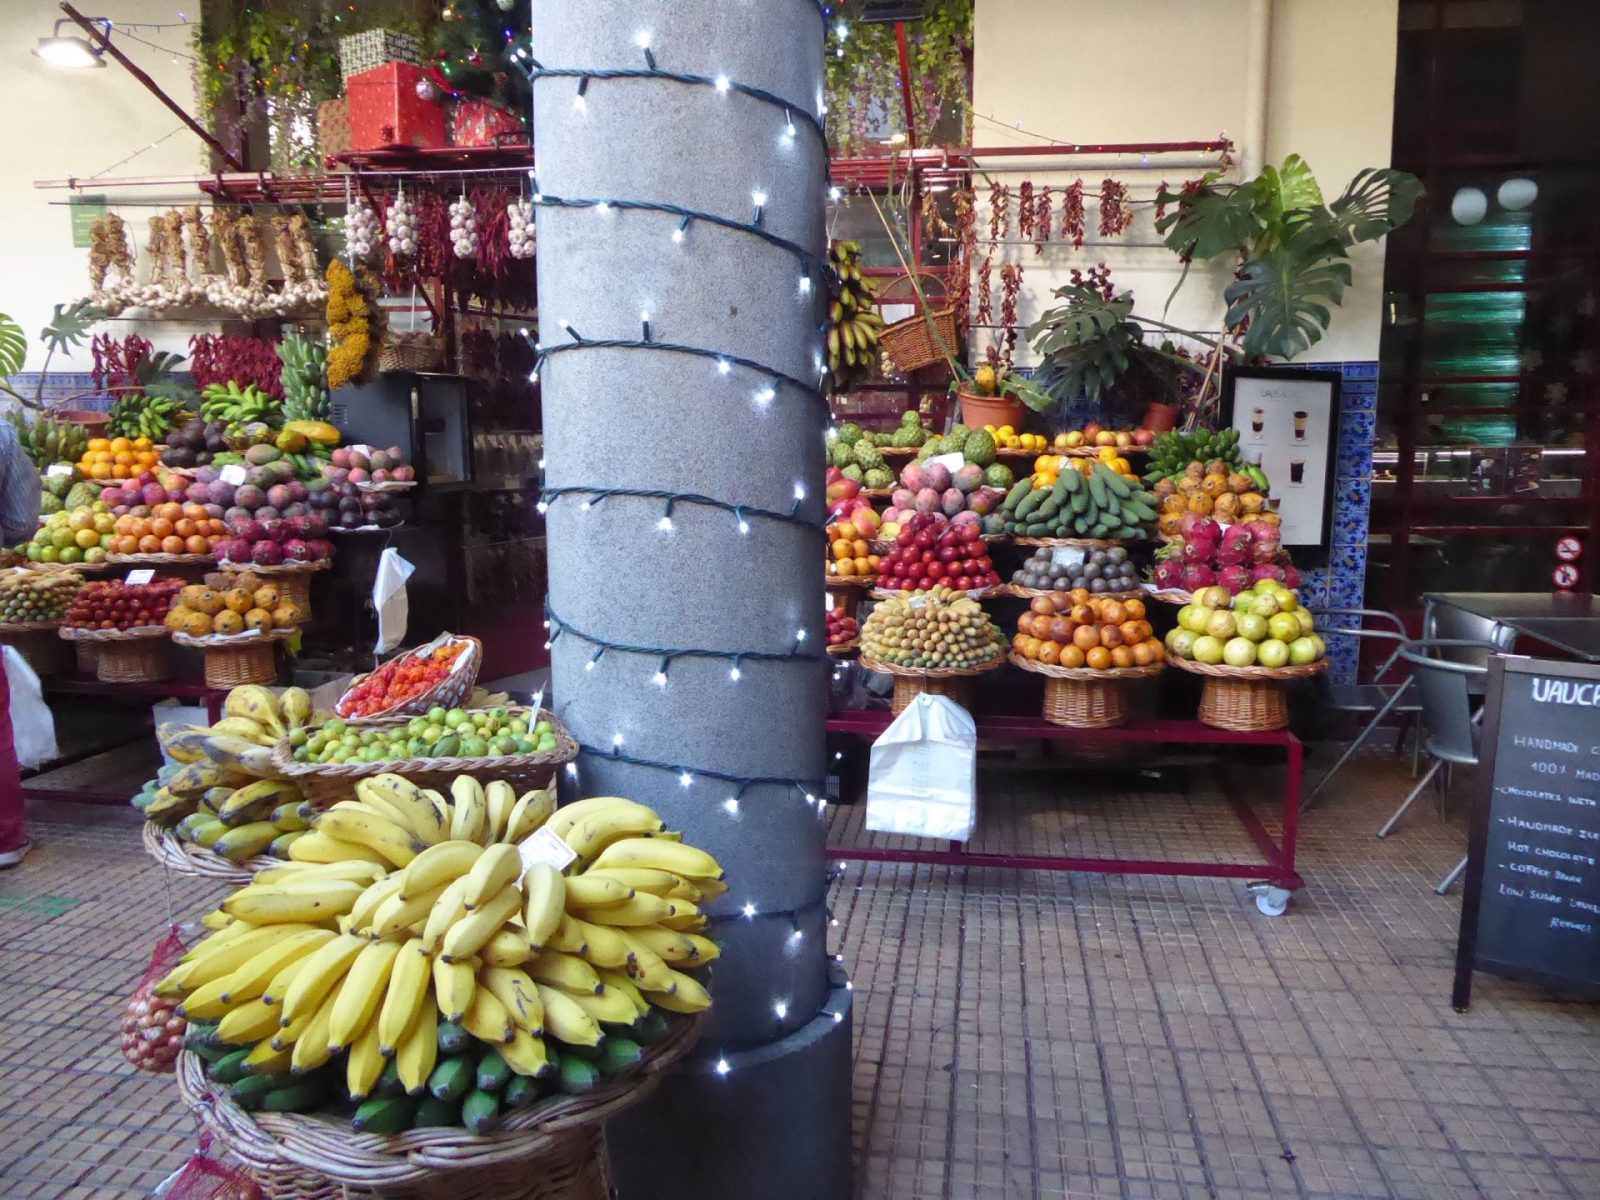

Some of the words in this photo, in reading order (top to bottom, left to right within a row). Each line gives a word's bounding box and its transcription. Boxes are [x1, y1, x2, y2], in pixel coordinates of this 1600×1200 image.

[1507, 816, 1573, 836] HANDMADE
[1507, 840, 1530, 853] HOT
[1535, 847, 1596, 866] CHOCOLATE
[1509, 863, 1550, 878] COFFEE
[1499, 883, 1525, 897] LOW
[1529, 889, 1562, 904] SUGAR
